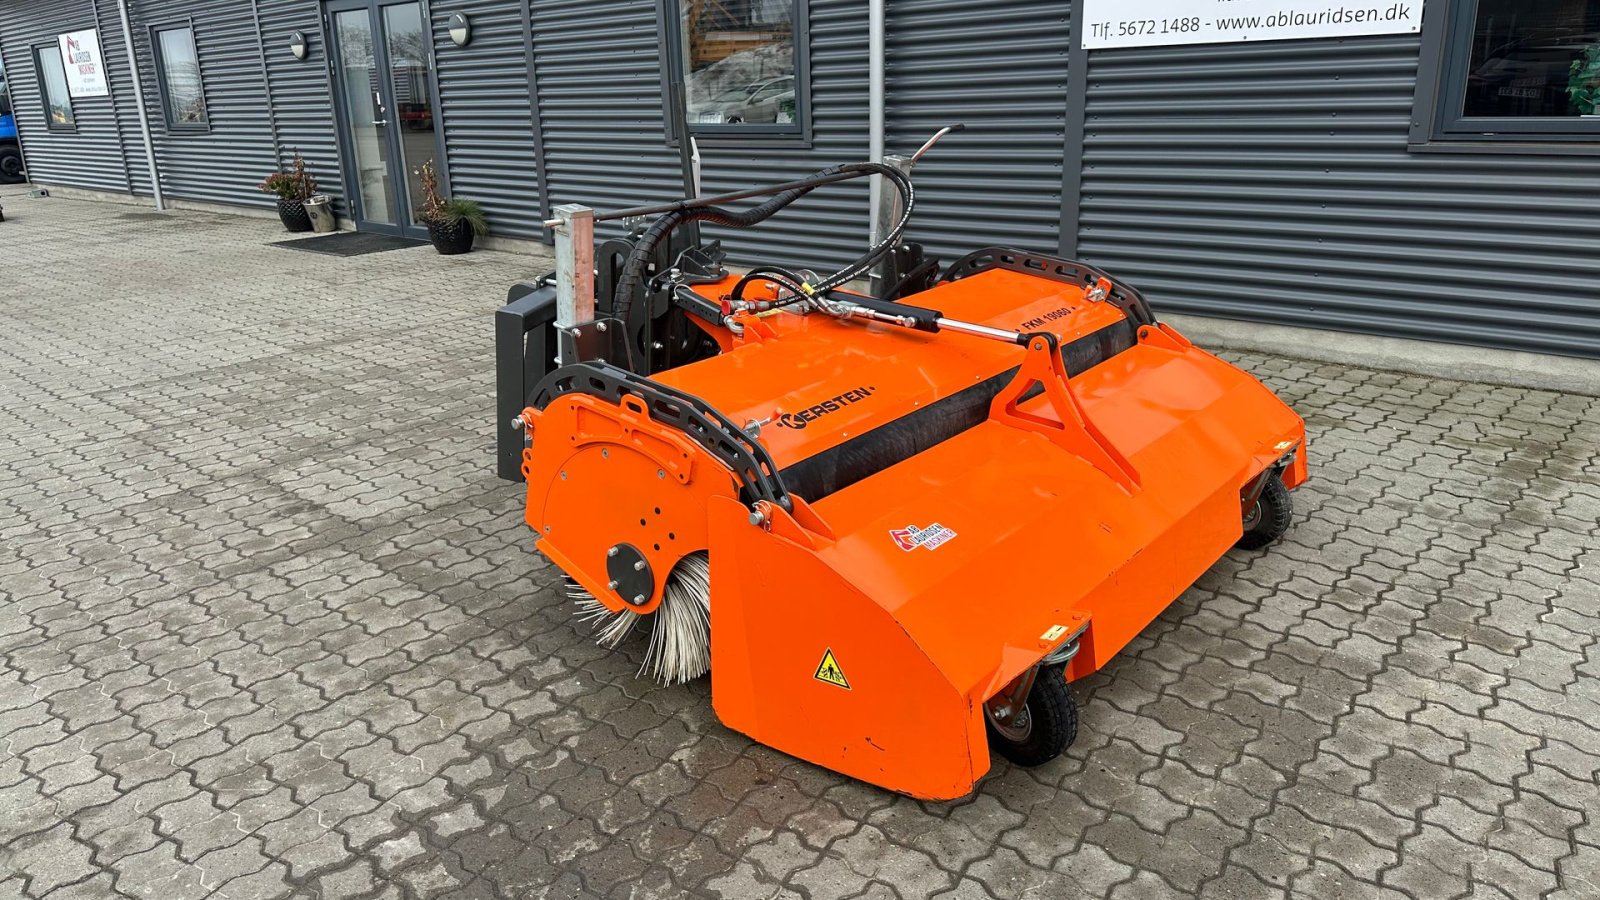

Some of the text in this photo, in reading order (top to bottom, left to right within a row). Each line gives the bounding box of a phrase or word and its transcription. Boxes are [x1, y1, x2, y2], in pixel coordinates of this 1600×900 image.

[1091, 22, 1114, 40] Tlf.
[1118, 20, 1156, 37] 5672
[1160, 17, 1200, 34] 1488
[1216, 3, 1411, 31] www.ablauridsen.dk
[1021, 307, 1072, 330] FKM 19060
[780, 387, 872, 430] KERSTEN
